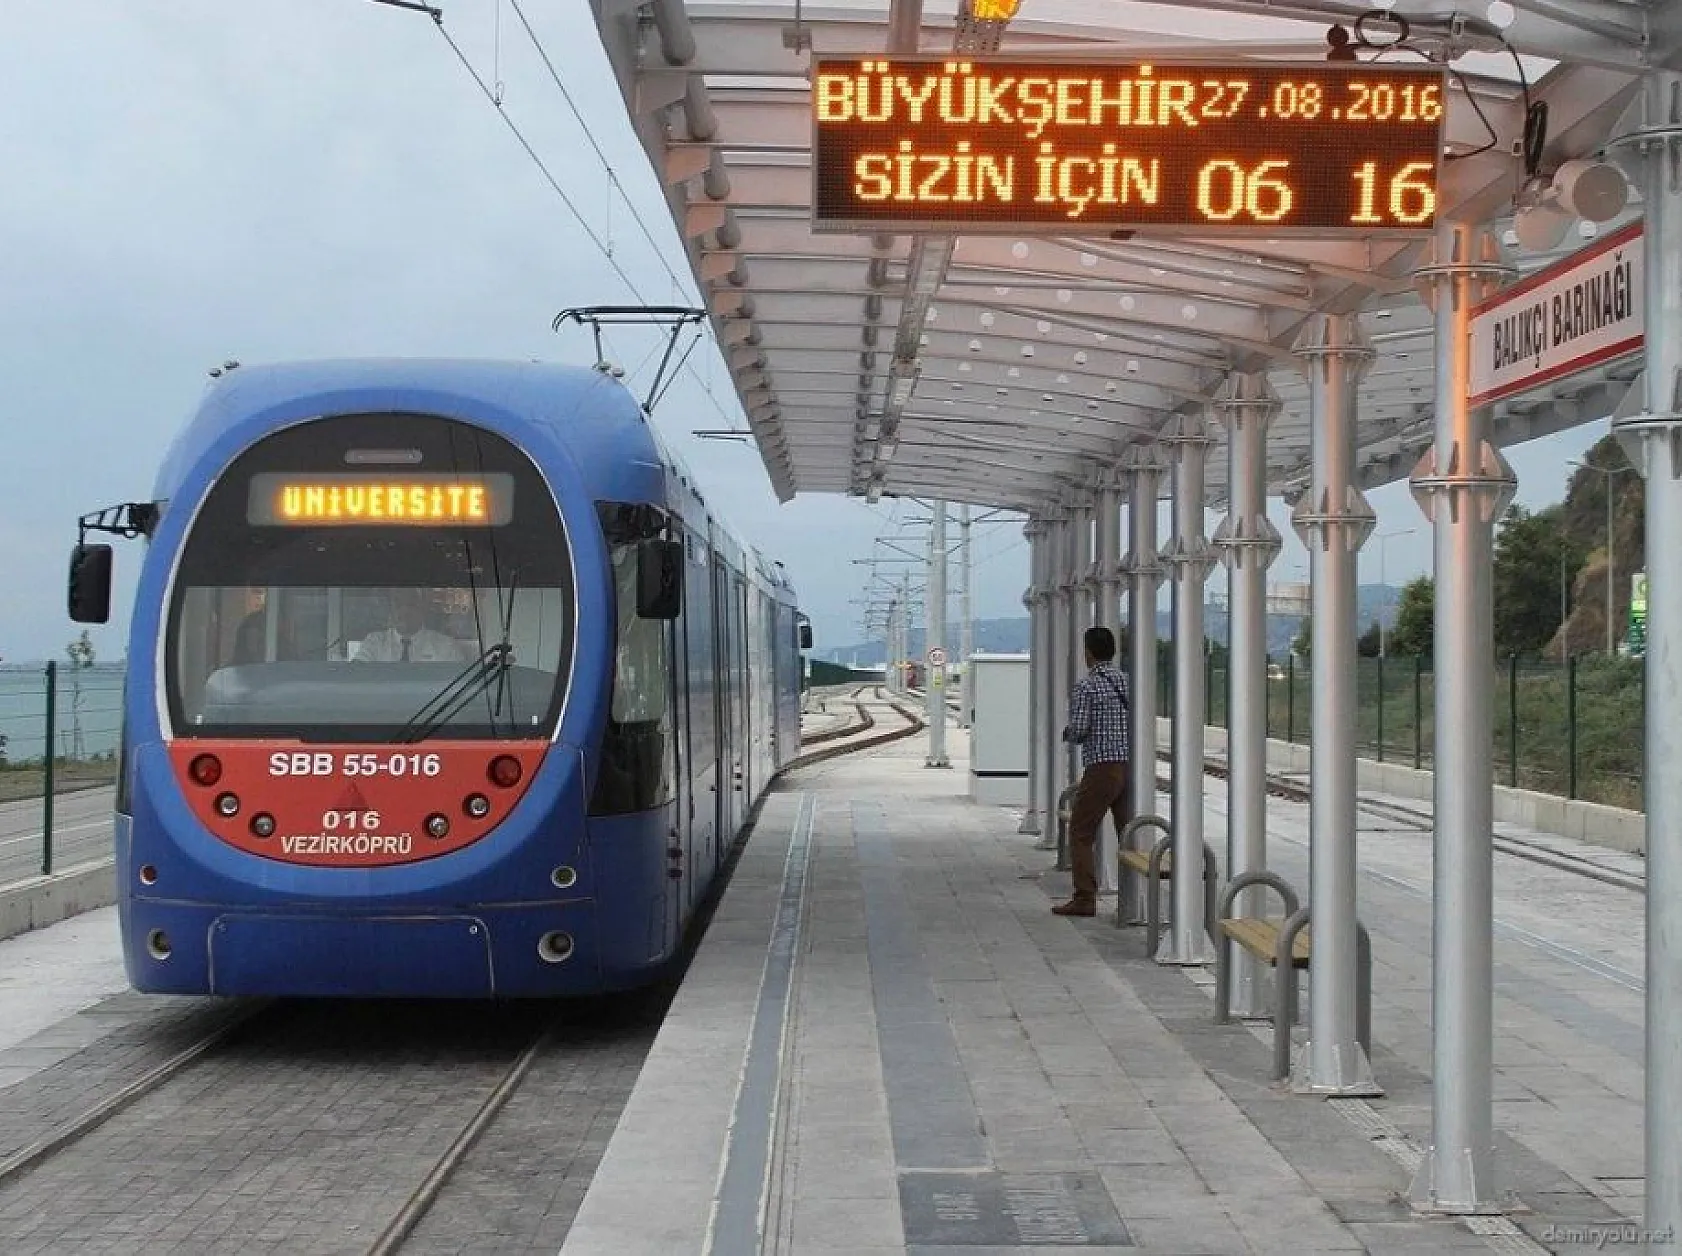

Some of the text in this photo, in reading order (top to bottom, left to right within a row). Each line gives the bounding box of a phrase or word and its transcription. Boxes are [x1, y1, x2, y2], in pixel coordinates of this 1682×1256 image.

[816, 61, 1200, 138] BÜYÜKŞEHİR
[854, 140, 1160, 217] SİZİN İÇİN
[1196, 160, 1436, 224] 06 16
[1493, 250, 1633, 370] BALIKÇI BARINAĞI
[269, 752, 441, 776] SBB 55-016
[281, 832, 412, 854] VEZİRKÖPRÜ
[322, 810, 381, 829] 016
